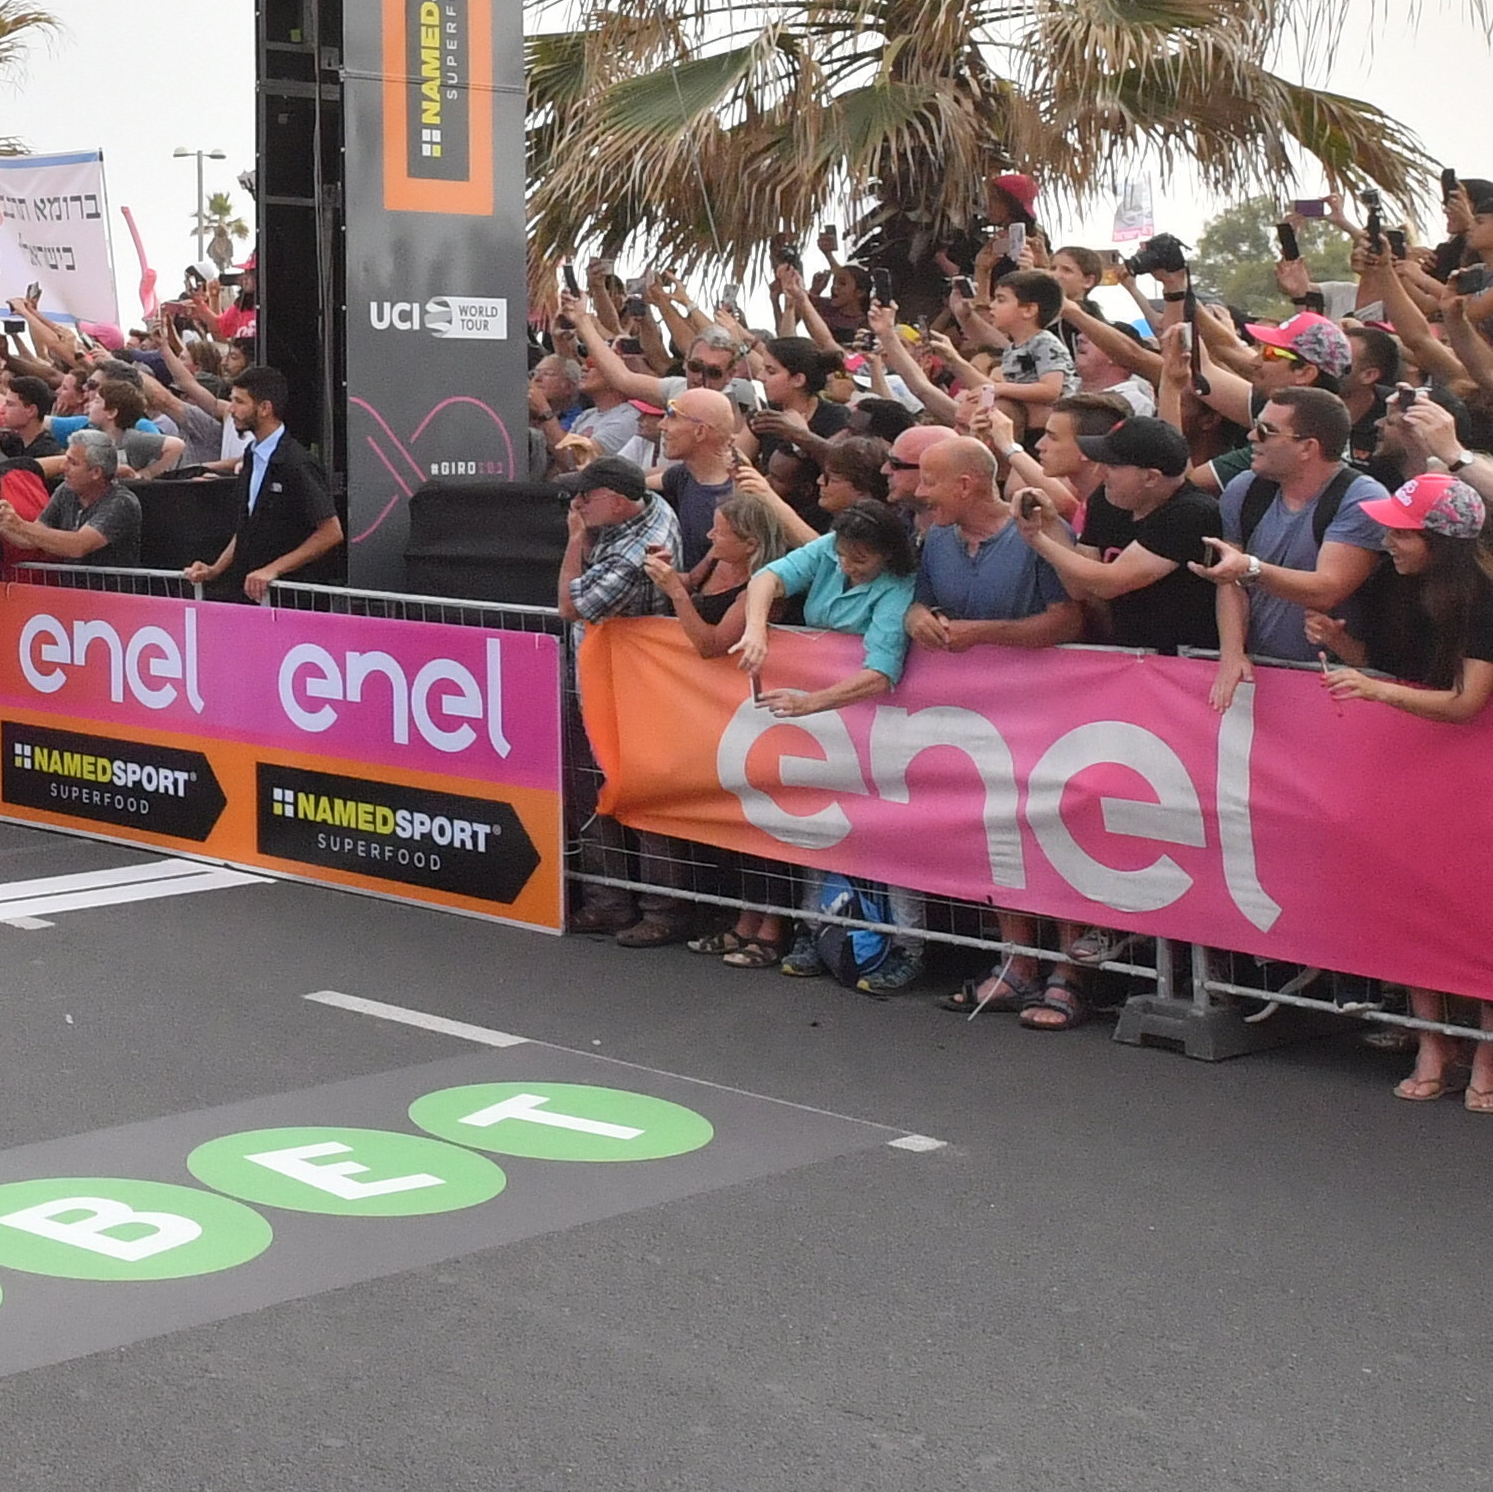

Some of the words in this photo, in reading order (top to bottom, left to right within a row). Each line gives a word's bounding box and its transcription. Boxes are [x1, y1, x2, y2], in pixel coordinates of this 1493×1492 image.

[370, 301, 420, 331] UCI
[458, 305, 498, 318] WORLD
[460, 318, 489, 331] TOUR
[19, 608, 205, 714] enel
[278, 637, 512, 759] enel
[50, 782, 151, 815] SUPERFOOD
[717, 679, 1283, 934] enel
[317, 830, 442, 873] SUPERFOOD
